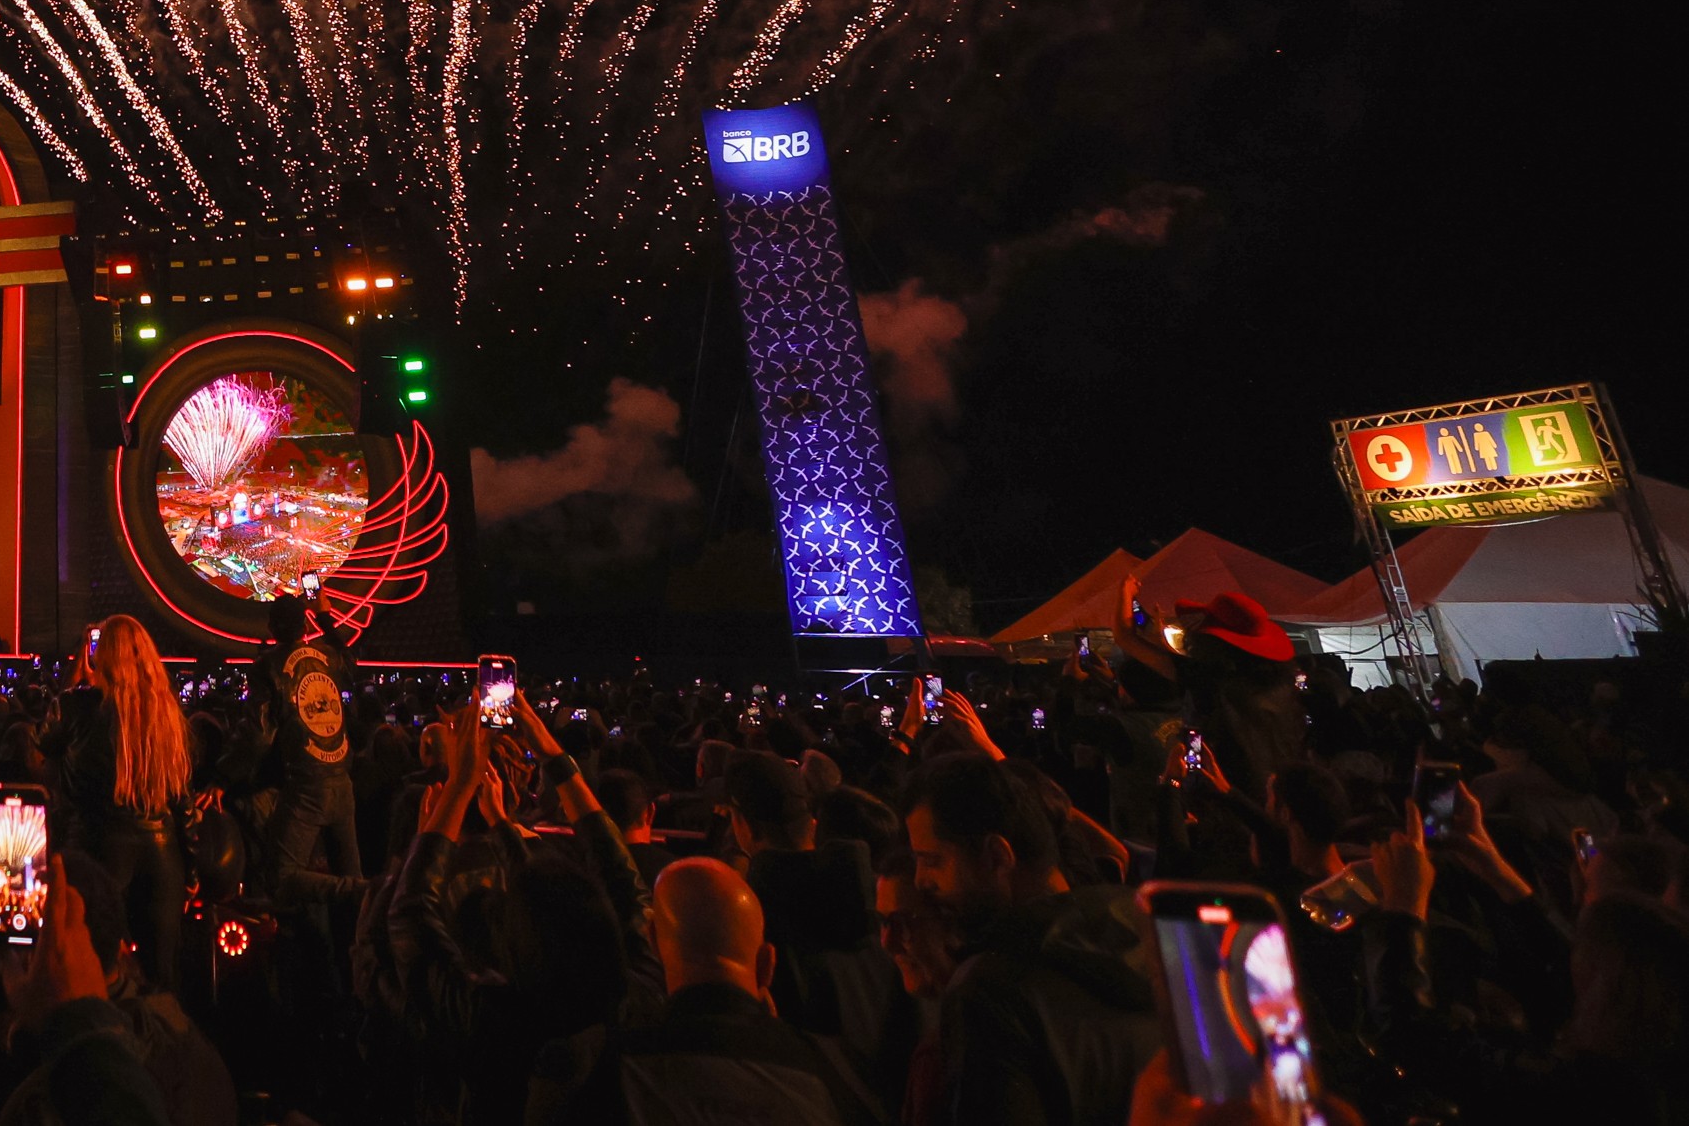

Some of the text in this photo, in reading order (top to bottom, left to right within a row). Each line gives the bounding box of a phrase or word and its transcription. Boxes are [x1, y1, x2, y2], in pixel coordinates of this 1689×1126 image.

[722, 130, 752, 138] banco
[753, 130, 811, 162] BRB
[1389, 492, 1604, 524] SAÍDA DE EMERGÊNCIA
